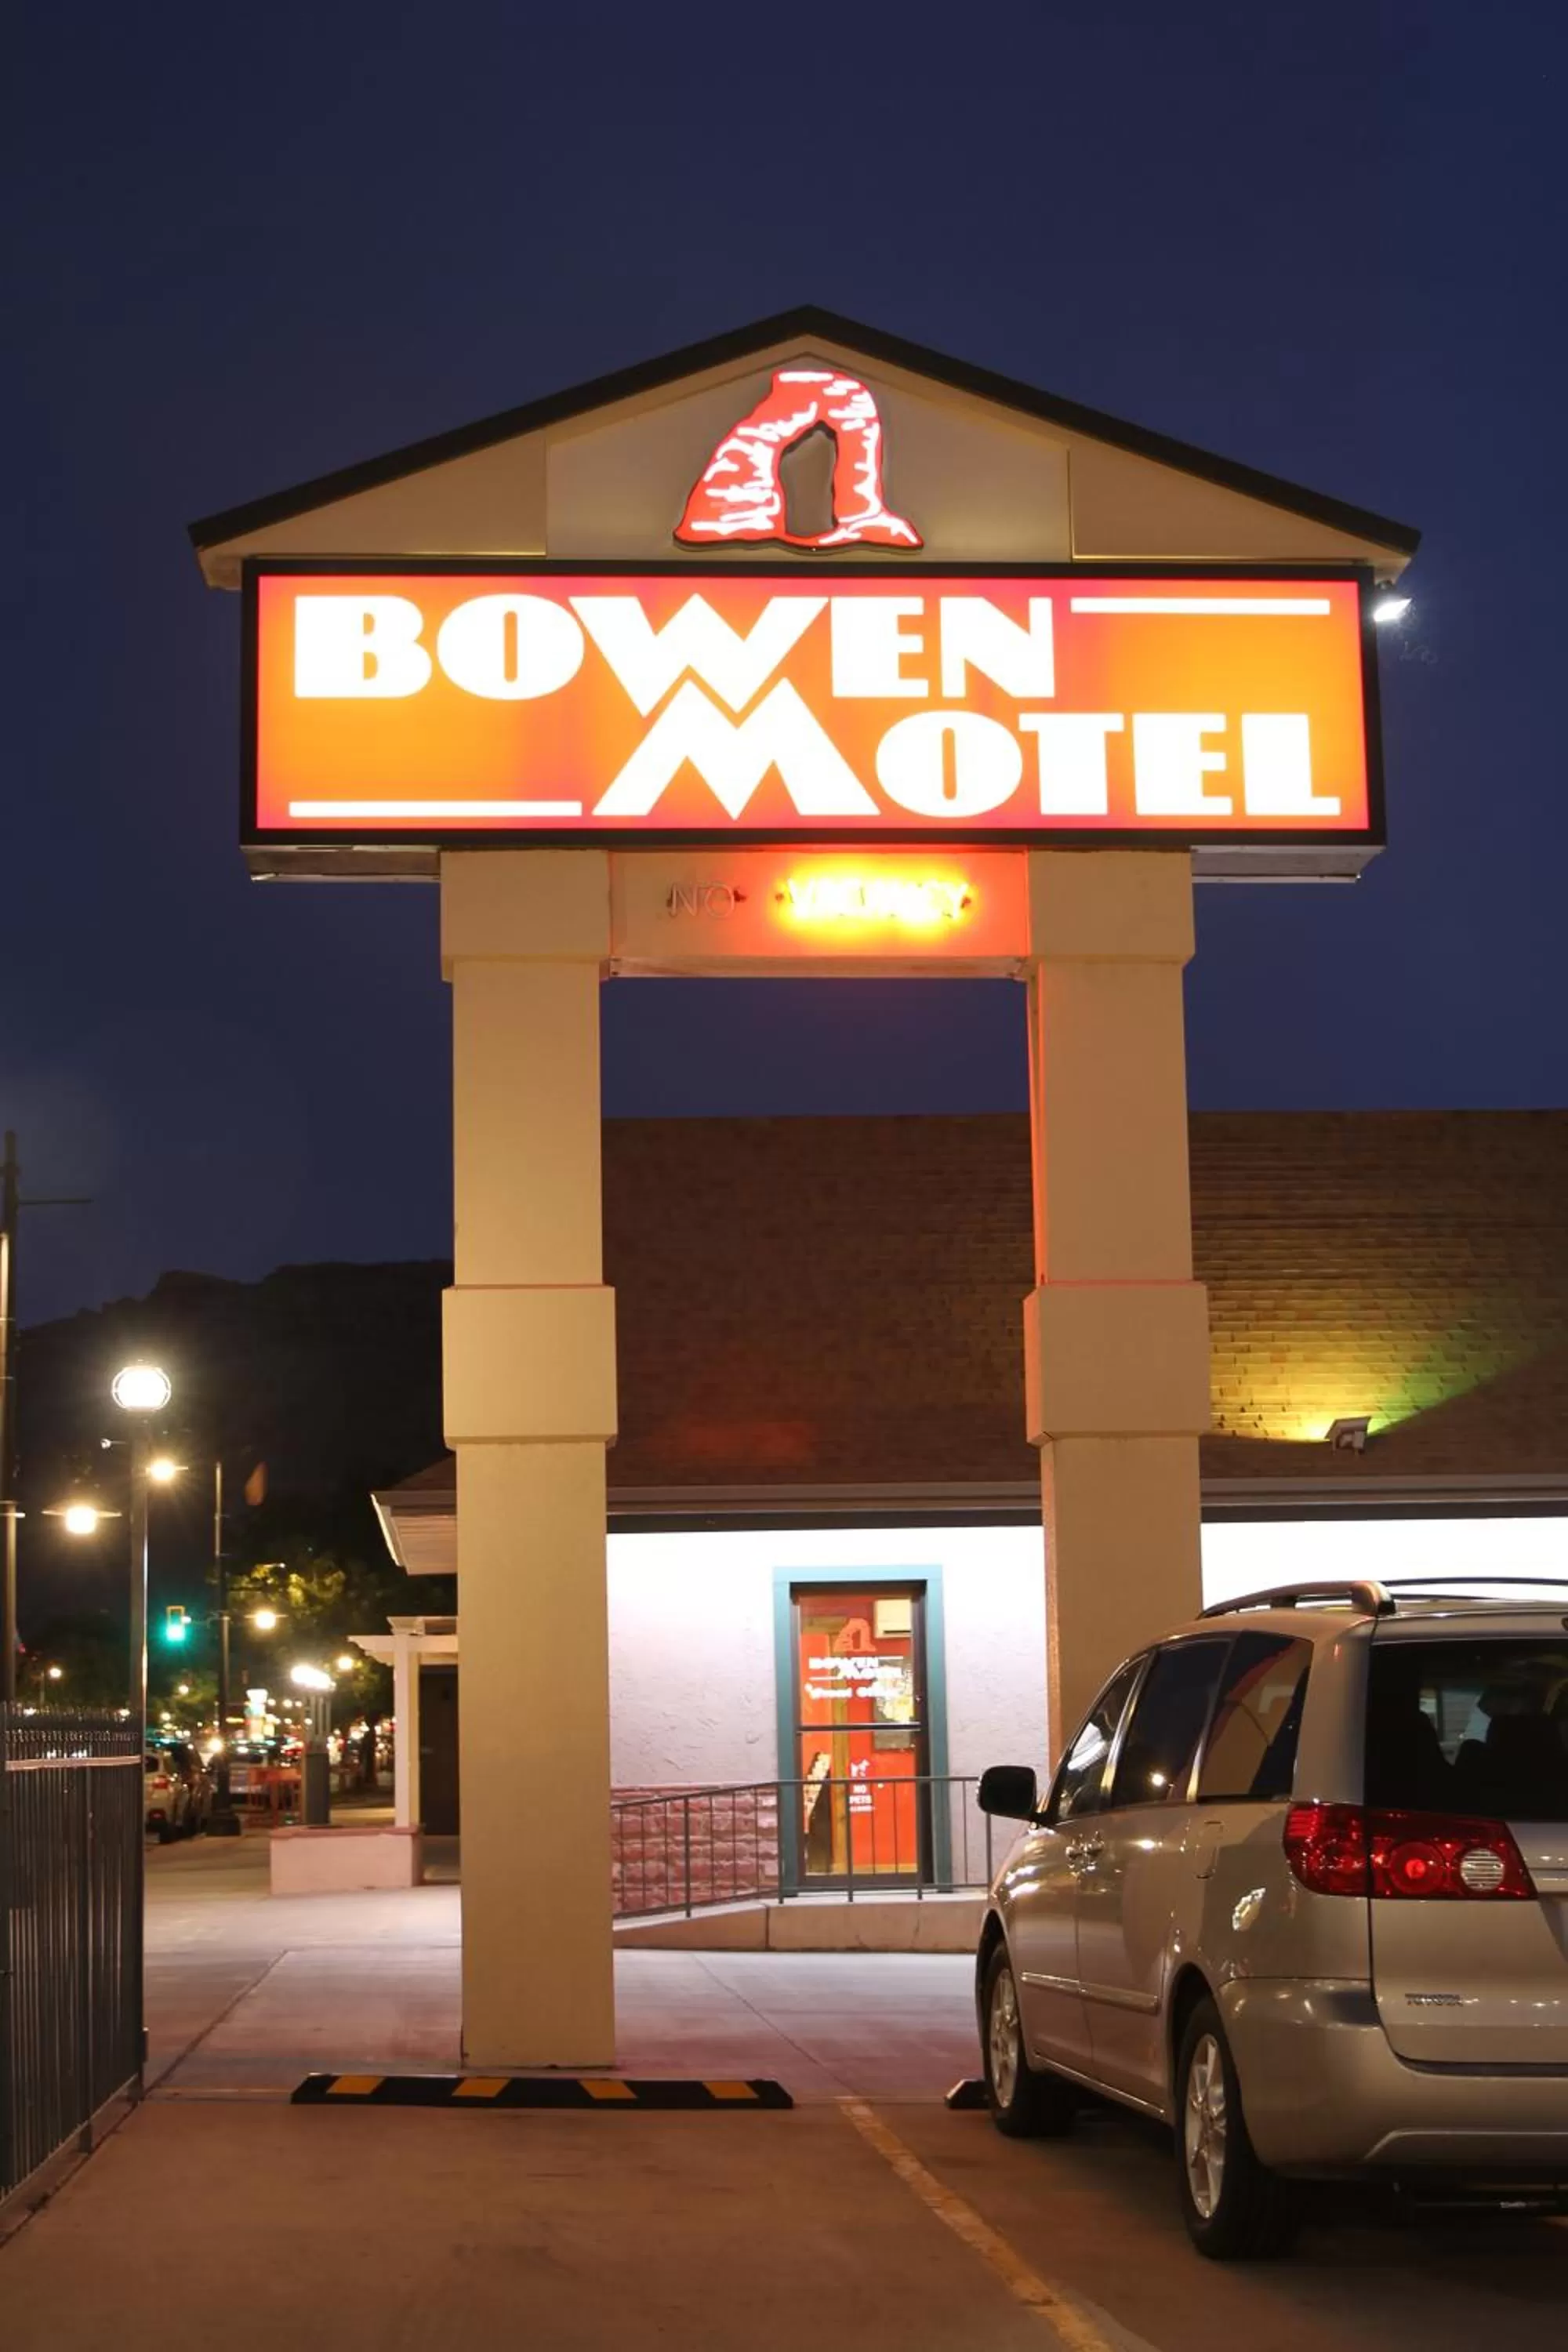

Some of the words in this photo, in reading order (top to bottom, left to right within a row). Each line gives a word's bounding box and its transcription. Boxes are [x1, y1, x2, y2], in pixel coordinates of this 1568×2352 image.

[295, 594, 1054, 717] BOWEN
[594, 678, 1341, 818] MOTEL
[669, 881, 736, 918] NO
[787, 877, 968, 921] VCCY
